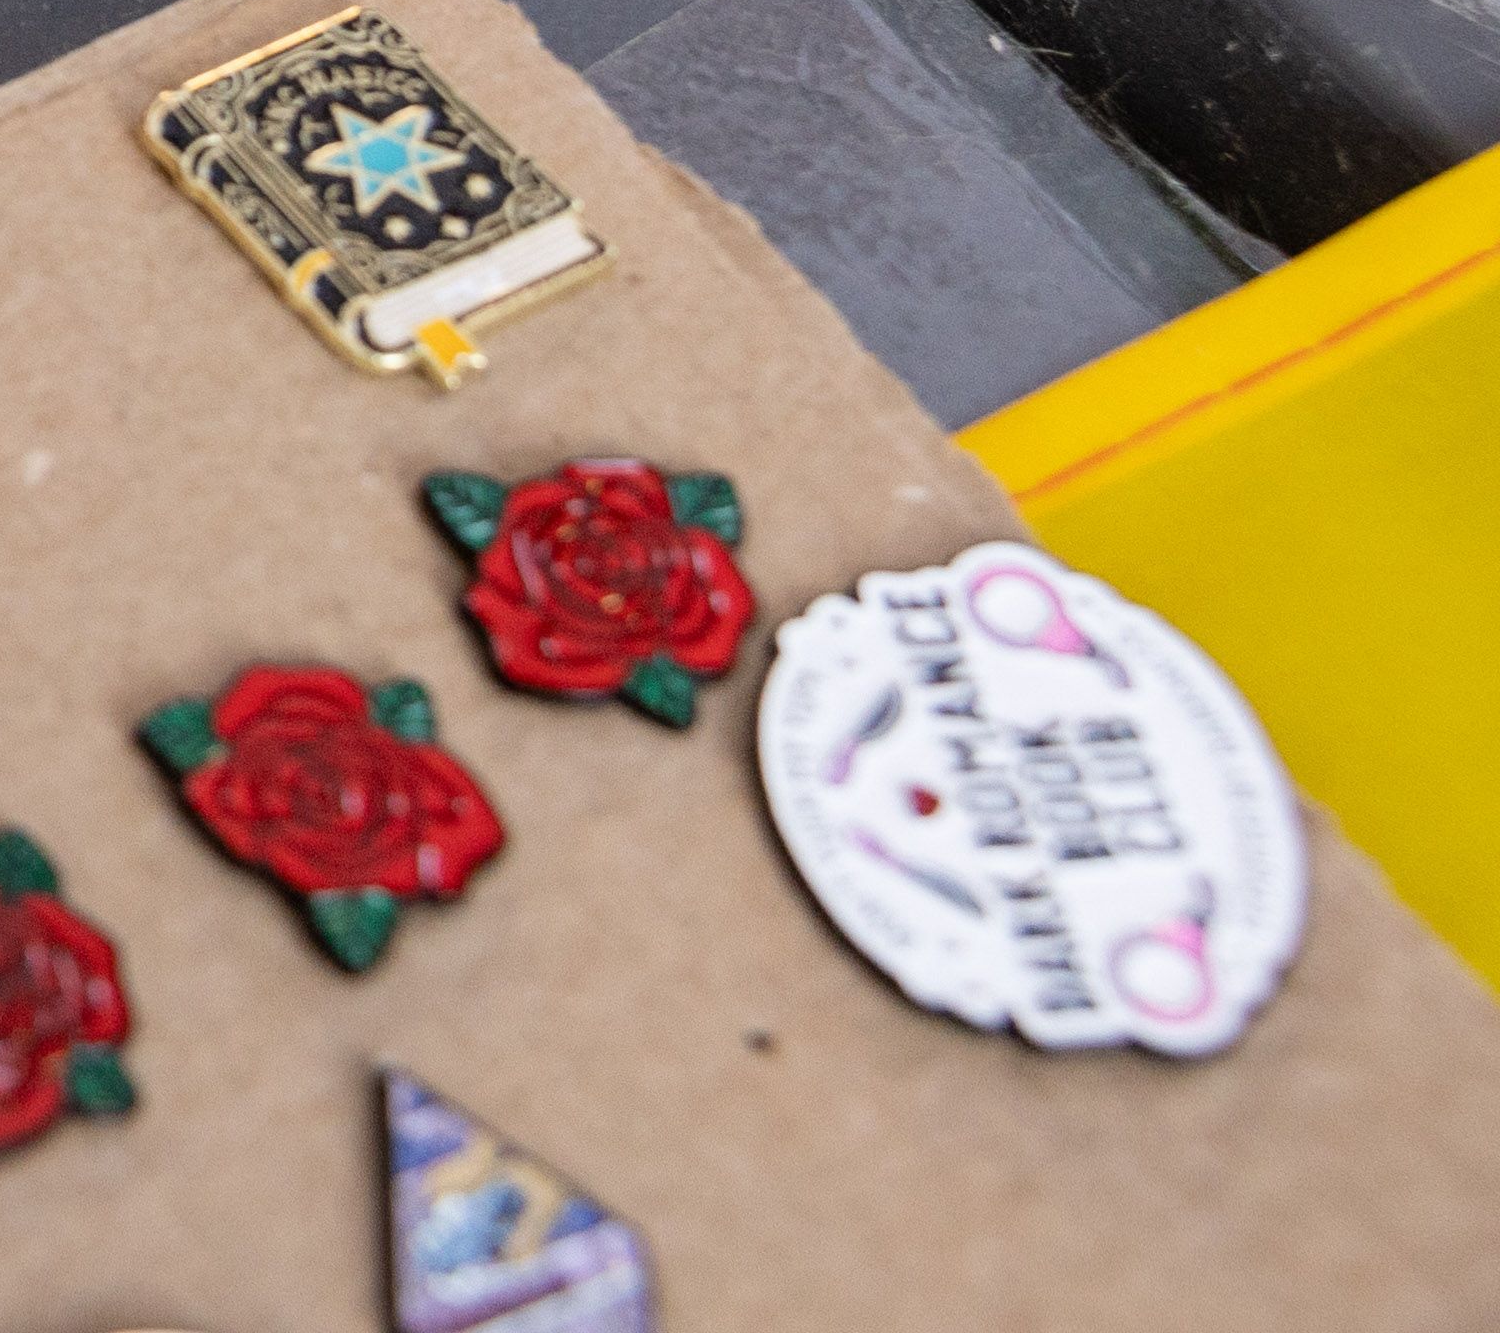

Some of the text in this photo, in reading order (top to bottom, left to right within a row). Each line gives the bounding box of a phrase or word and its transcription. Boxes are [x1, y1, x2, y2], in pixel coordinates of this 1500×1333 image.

[882, 589, 1098, 1012] DARK ROMANCE
[1010, 717, 1113, 862] BOOK
